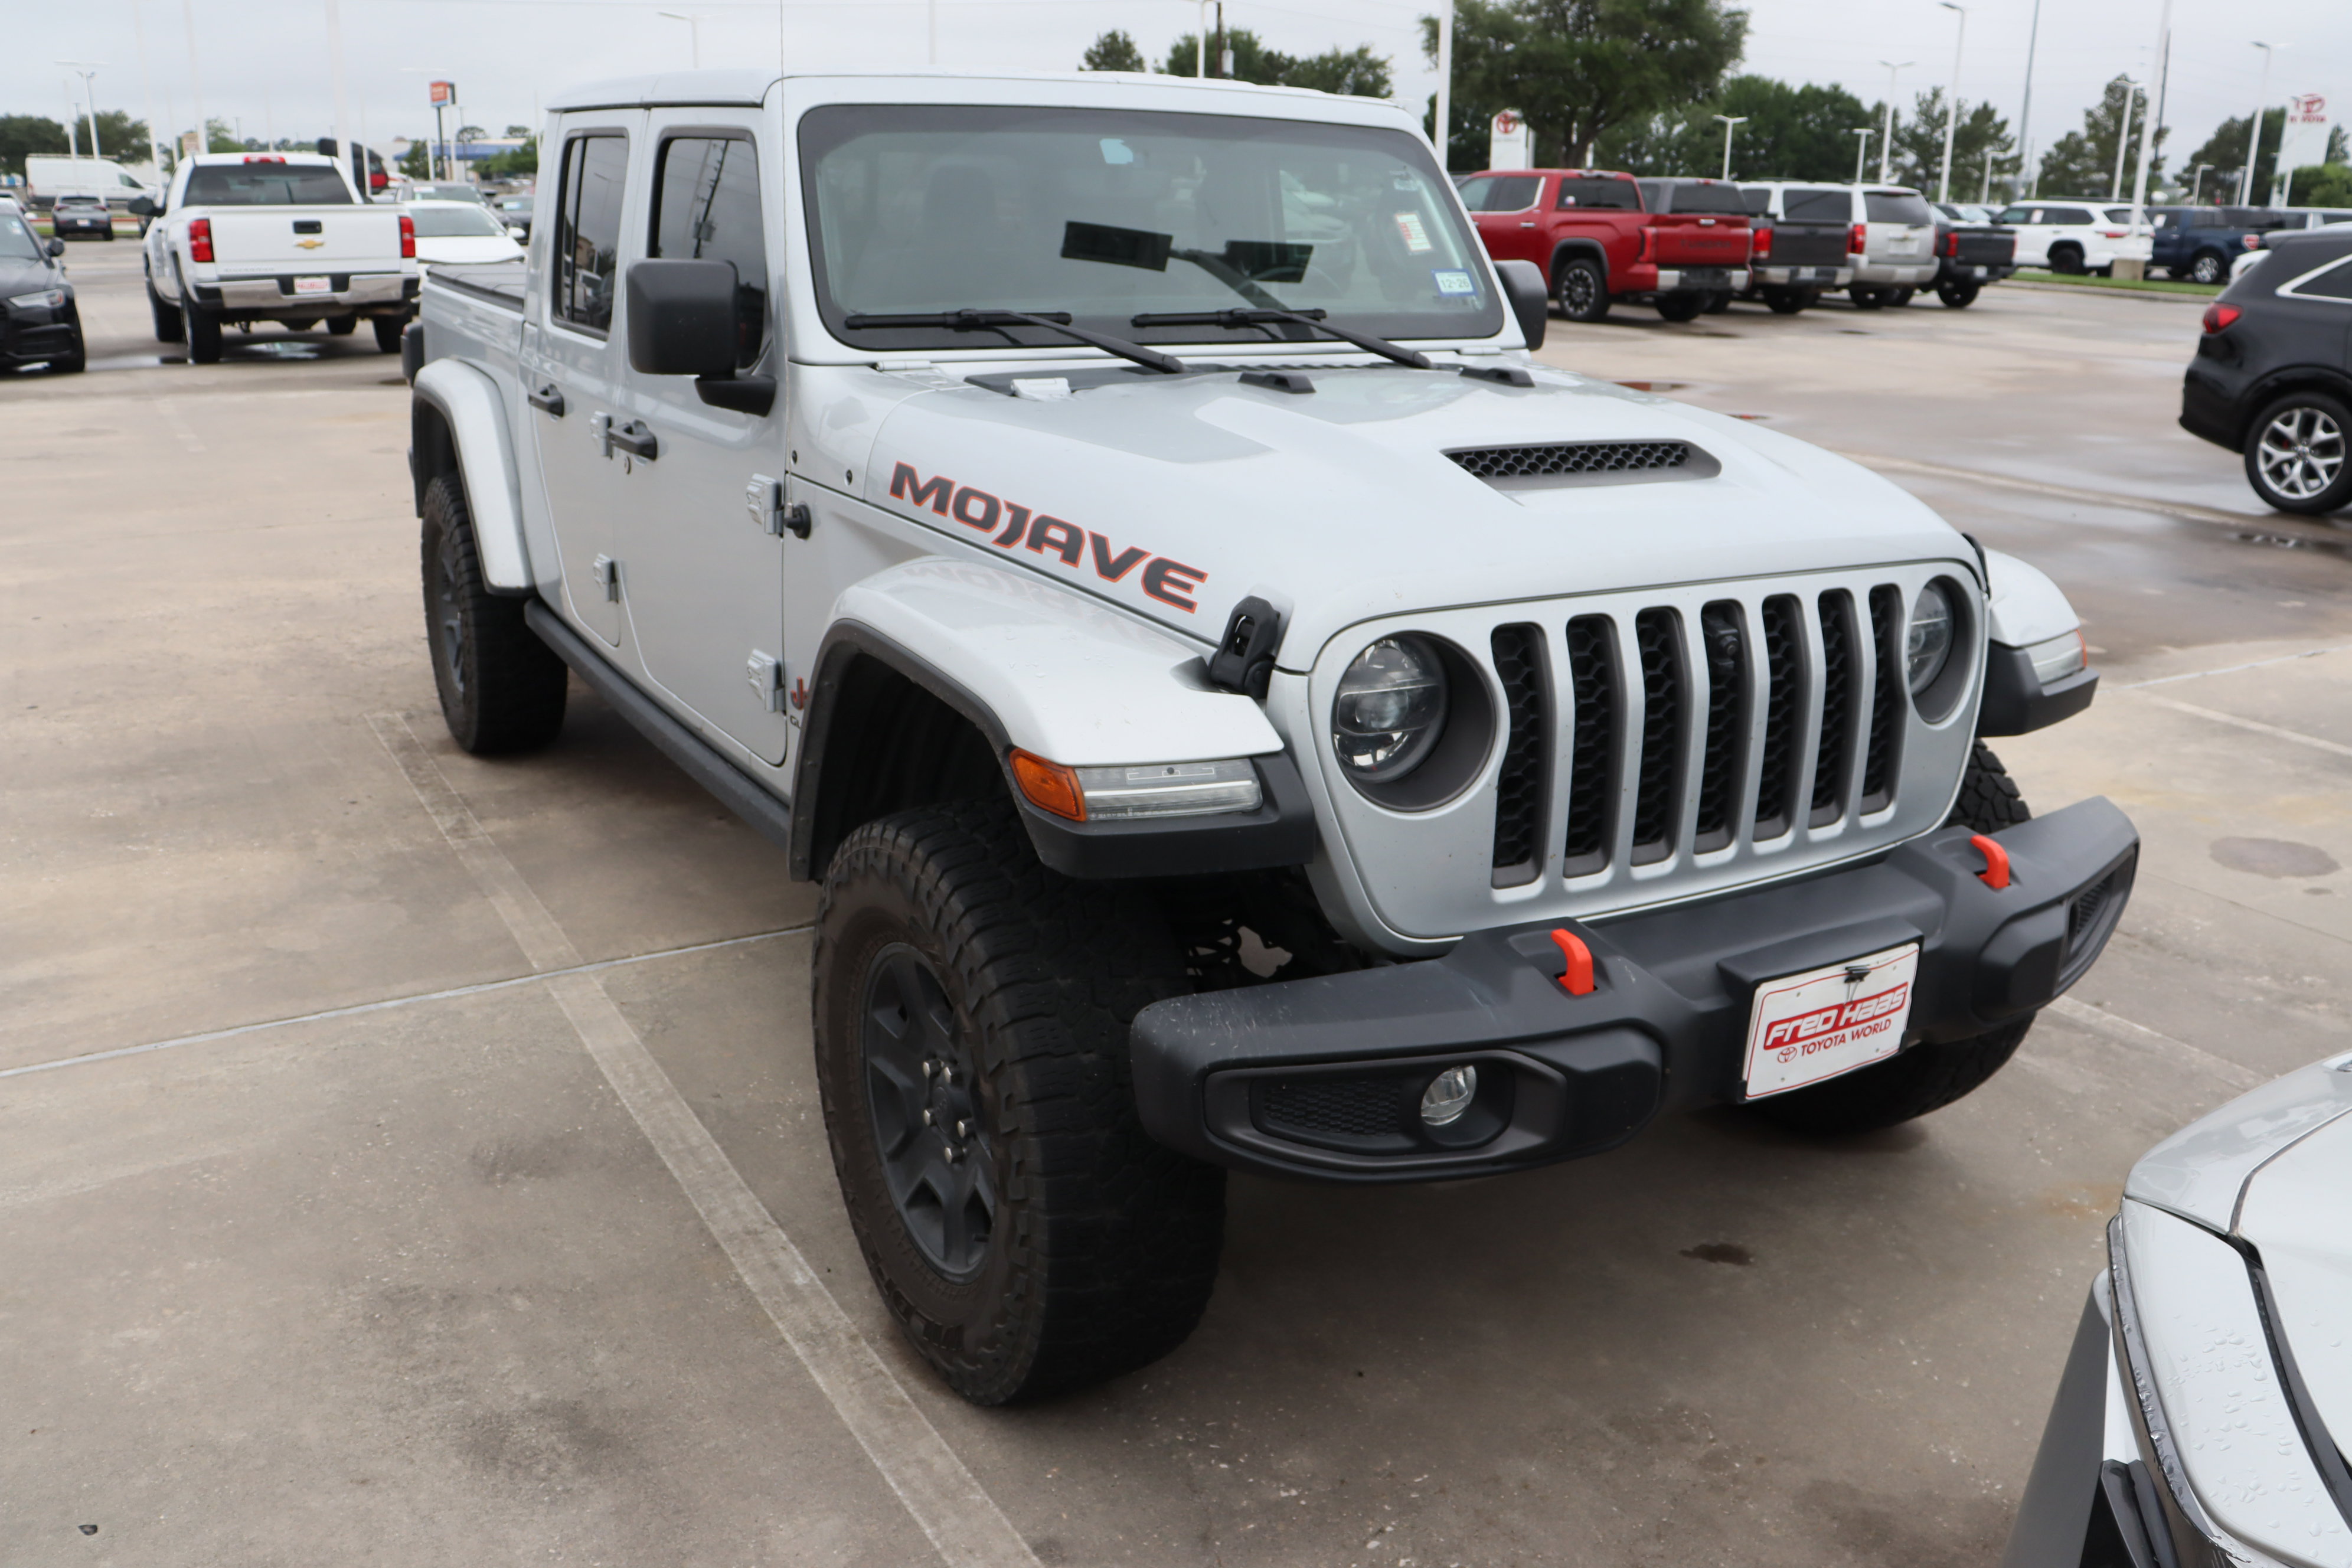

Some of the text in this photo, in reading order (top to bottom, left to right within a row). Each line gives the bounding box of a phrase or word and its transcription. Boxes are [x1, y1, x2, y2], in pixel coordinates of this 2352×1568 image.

[889, 460, 1208, 615] MOJAVE
[1801, 1018, 1892, 1057] TOYOTA WORLD
